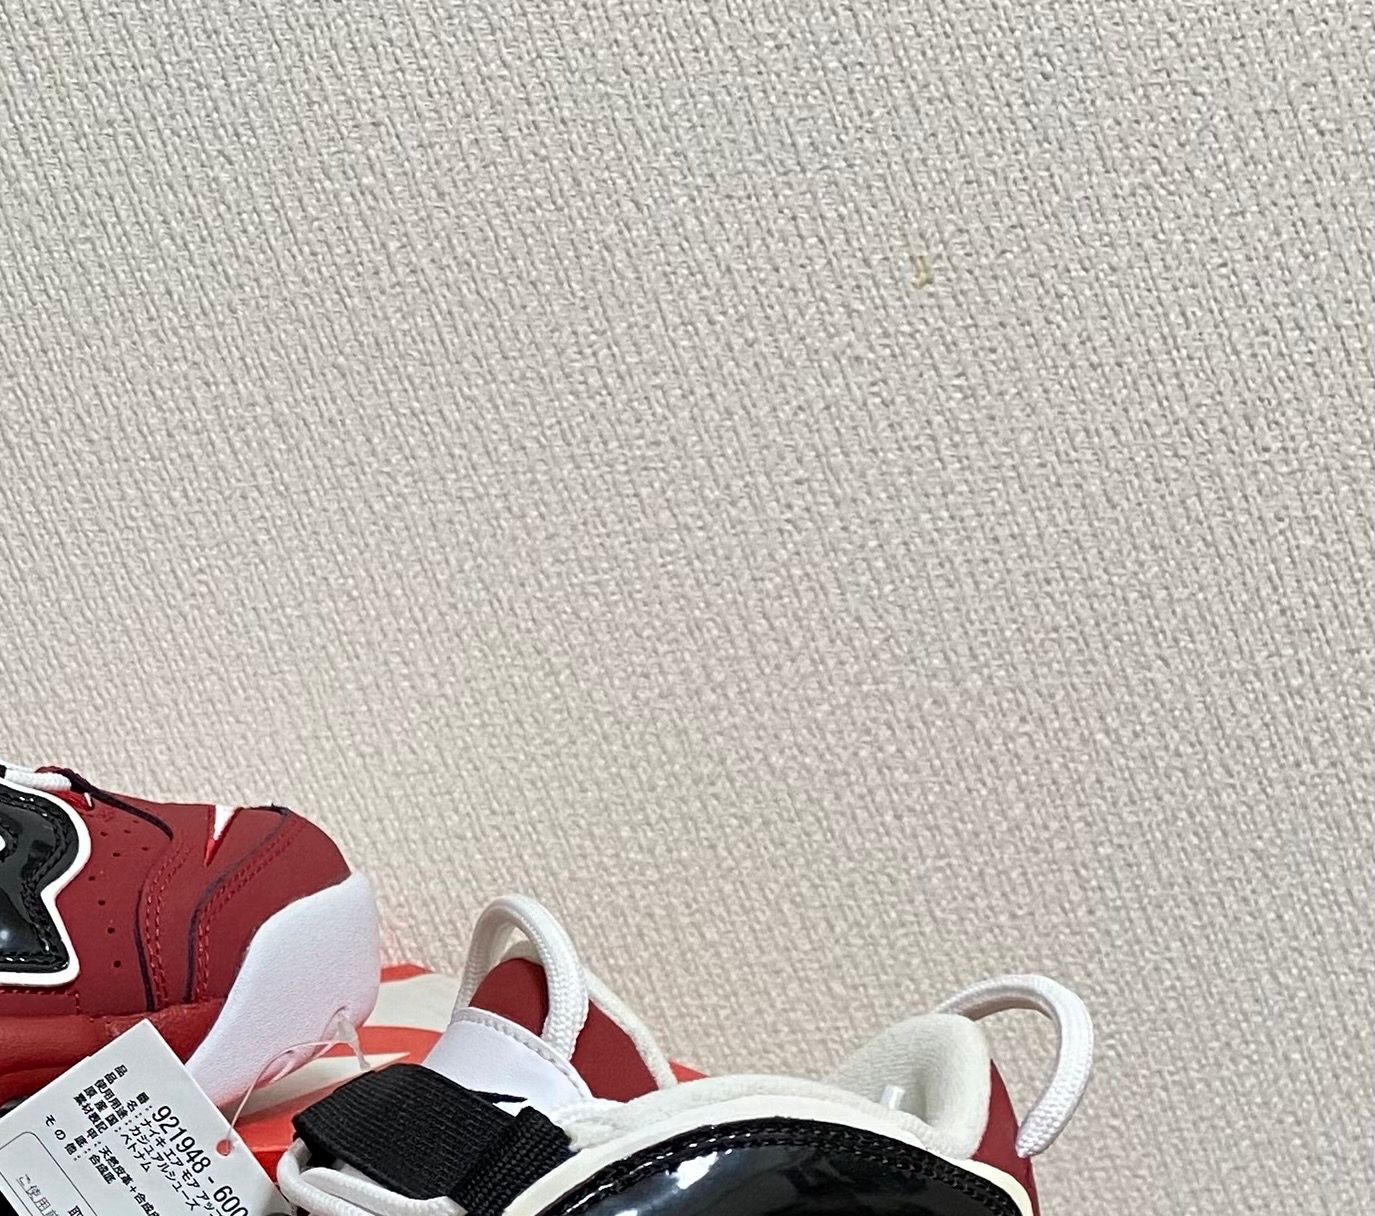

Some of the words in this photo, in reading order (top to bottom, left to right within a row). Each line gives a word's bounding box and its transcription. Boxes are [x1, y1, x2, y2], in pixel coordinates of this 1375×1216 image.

[119, 1133, 152, 1173] ベトナム
[139, 1117, 167, 1148] ナイキ
[162, 1147, 185, 1167] エア
[181, 1168, 201, 1189] モア
[151, 1105, 212, 1174] 921948
